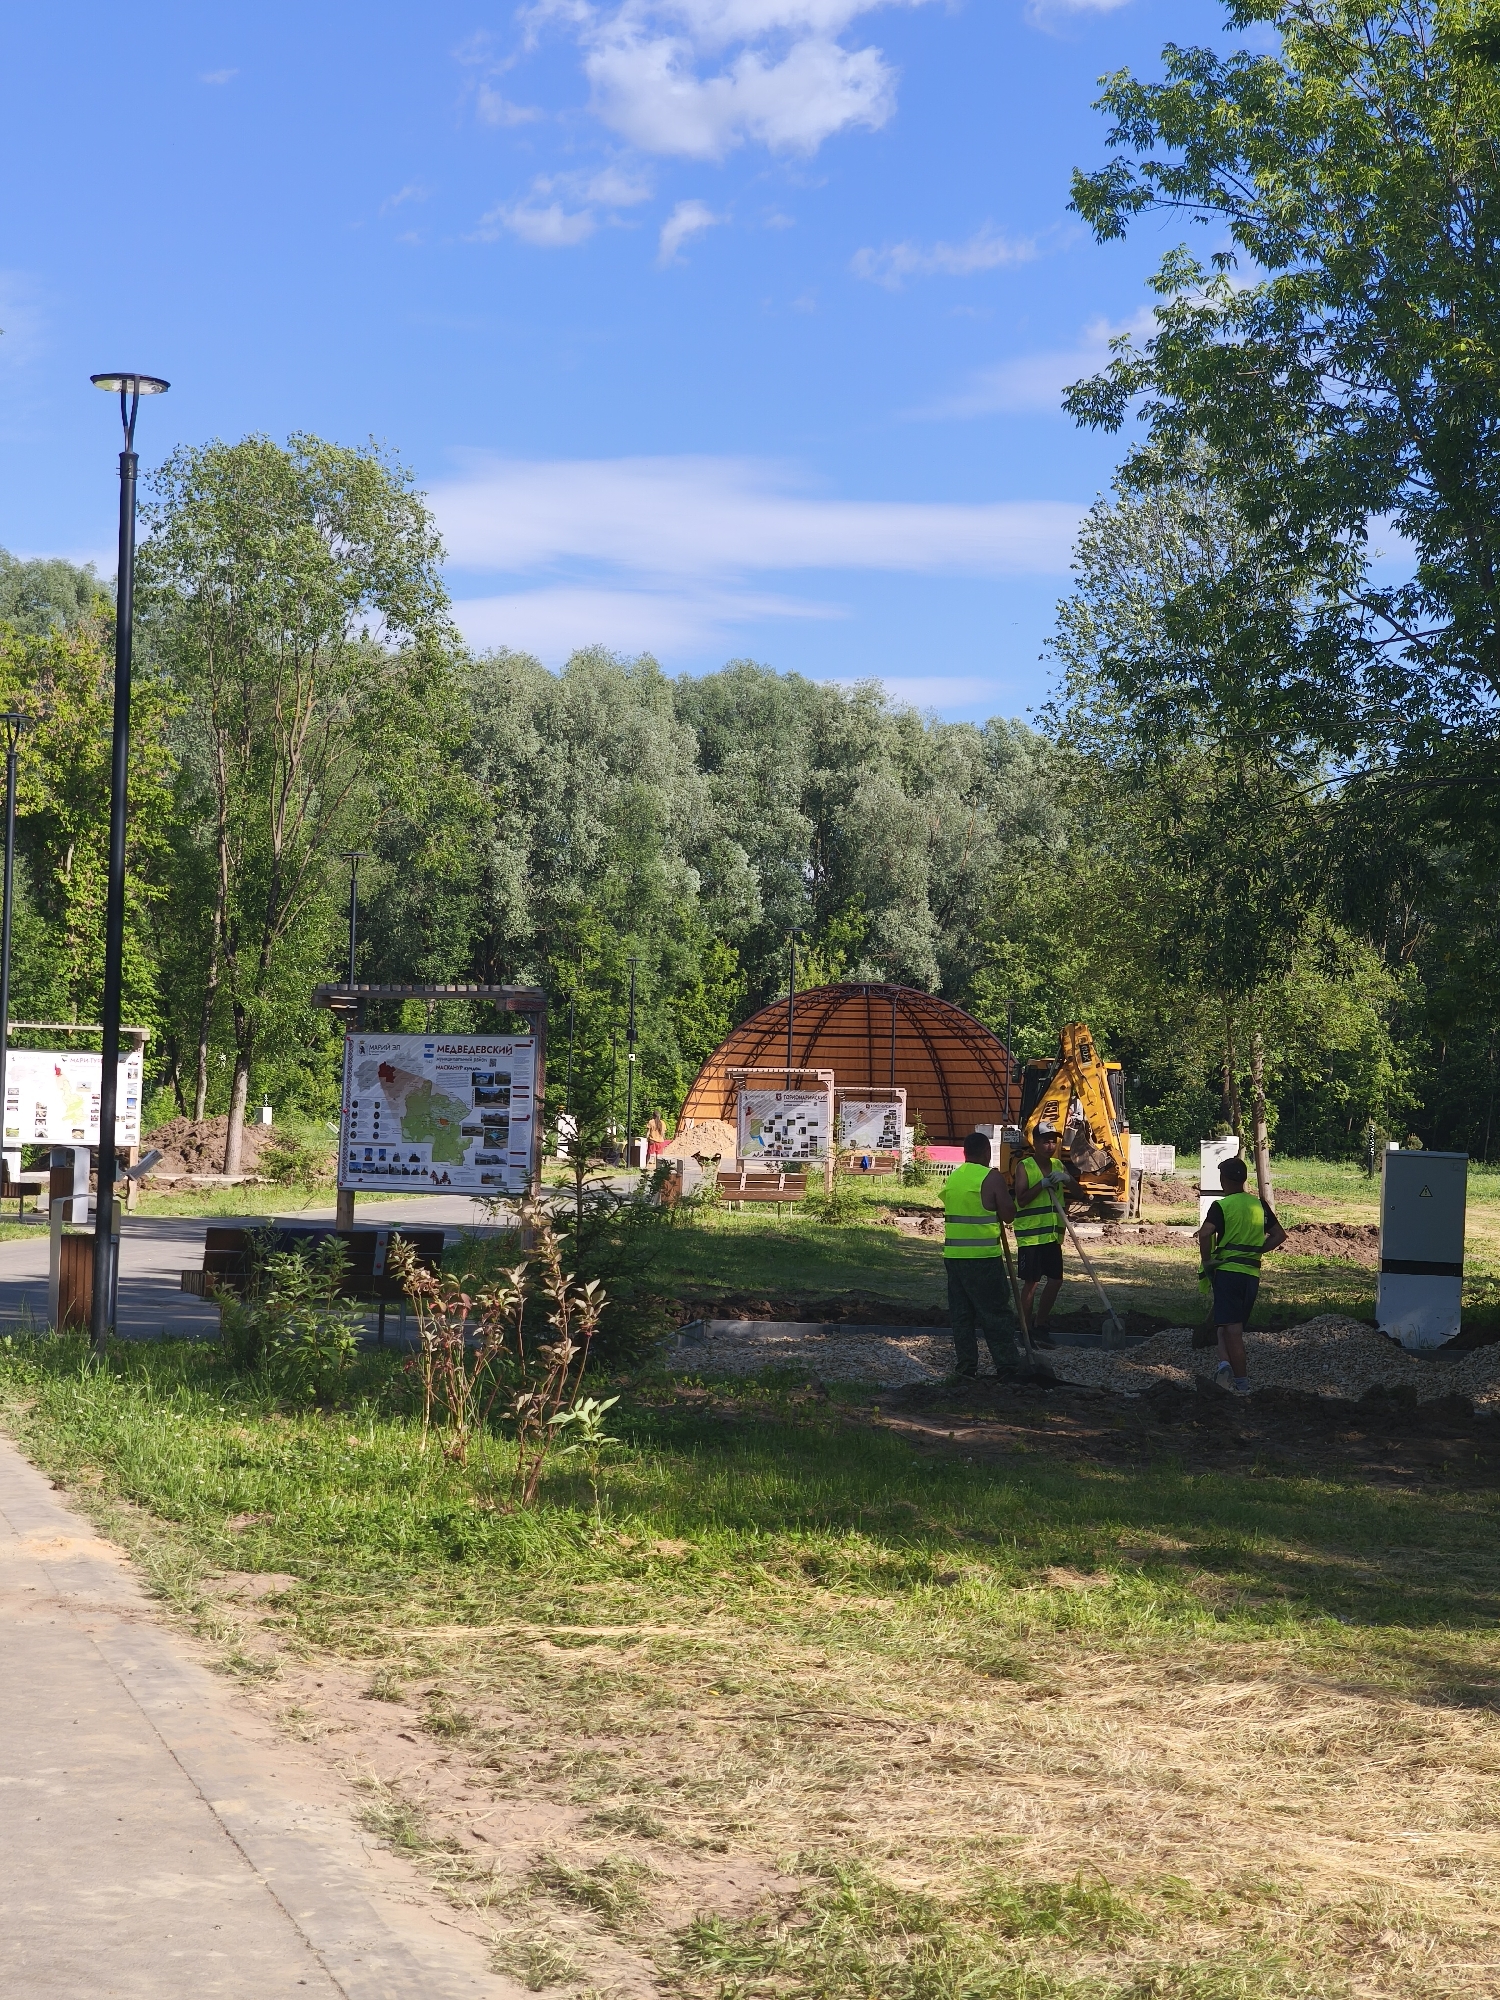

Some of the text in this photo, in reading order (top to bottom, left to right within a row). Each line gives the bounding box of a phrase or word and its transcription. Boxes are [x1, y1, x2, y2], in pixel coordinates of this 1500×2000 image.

[369, 1043, 390, 1051] МАРИЙ
[437, 1044, 513, 1055] МЕДВЕДЕВСКИЙ
[1042, 1101, 1058, 1121] JCB
